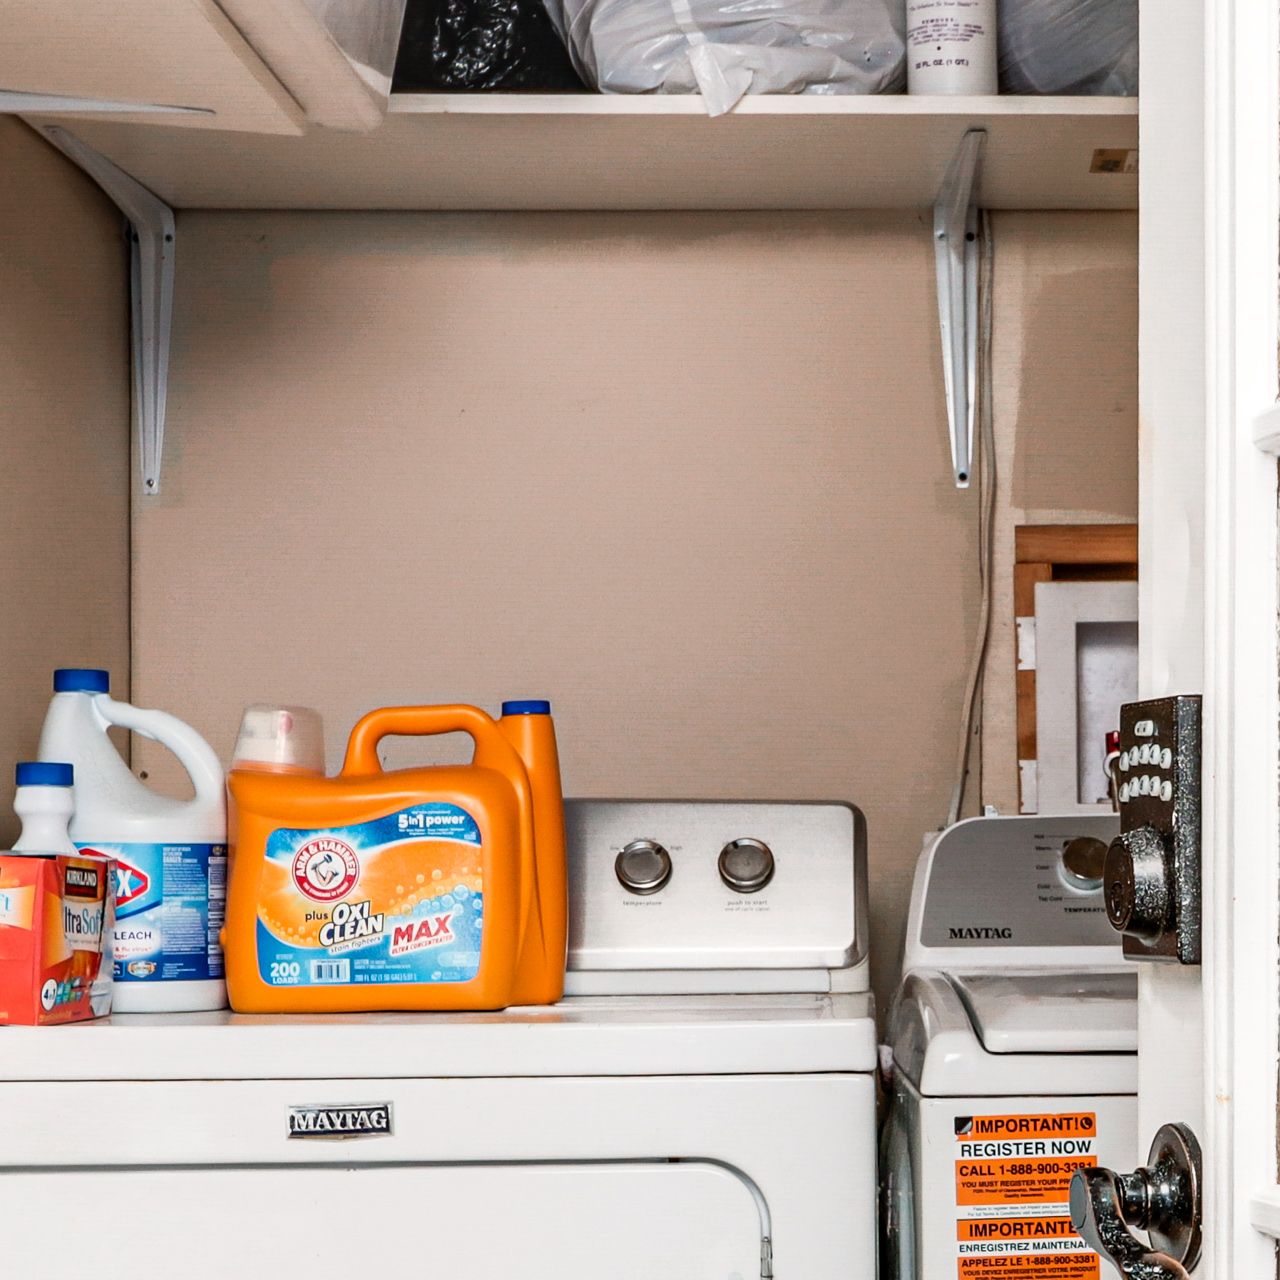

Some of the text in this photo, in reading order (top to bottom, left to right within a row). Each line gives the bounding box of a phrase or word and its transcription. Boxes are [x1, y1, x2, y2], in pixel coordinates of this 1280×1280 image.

[426, 815, 465, 827] power
[66, 869, 97, 887] KIRKLAND
[305, 900, 371, 926] plus OXI
[114, 931, 152, 940] LEACH
[319, 913, 385, 947] CLEAN
[393, 914, 451, 947] MAX
[949, 927, 1012, 939] MAYTAG
[271, 962, 301, 977] 200
[293, 1109, 387, 1132] MAYTAG
[975, 1117, 1079, 1133] IMPORTANT!
[961, 1140, 1092, 1157] REGISTER NOW
[960, 1165, 995, 1177] CALL
[1000, 1179, 1036, 1187] REGISTER
[1037, 1178, 1057, 1186] YOUR
[960, 1240, 1087, 1253] ENREGISTREZ MAINTENA
[962, 1255, 1095, 1267] APPELEZ LE 1-888-900-3381
